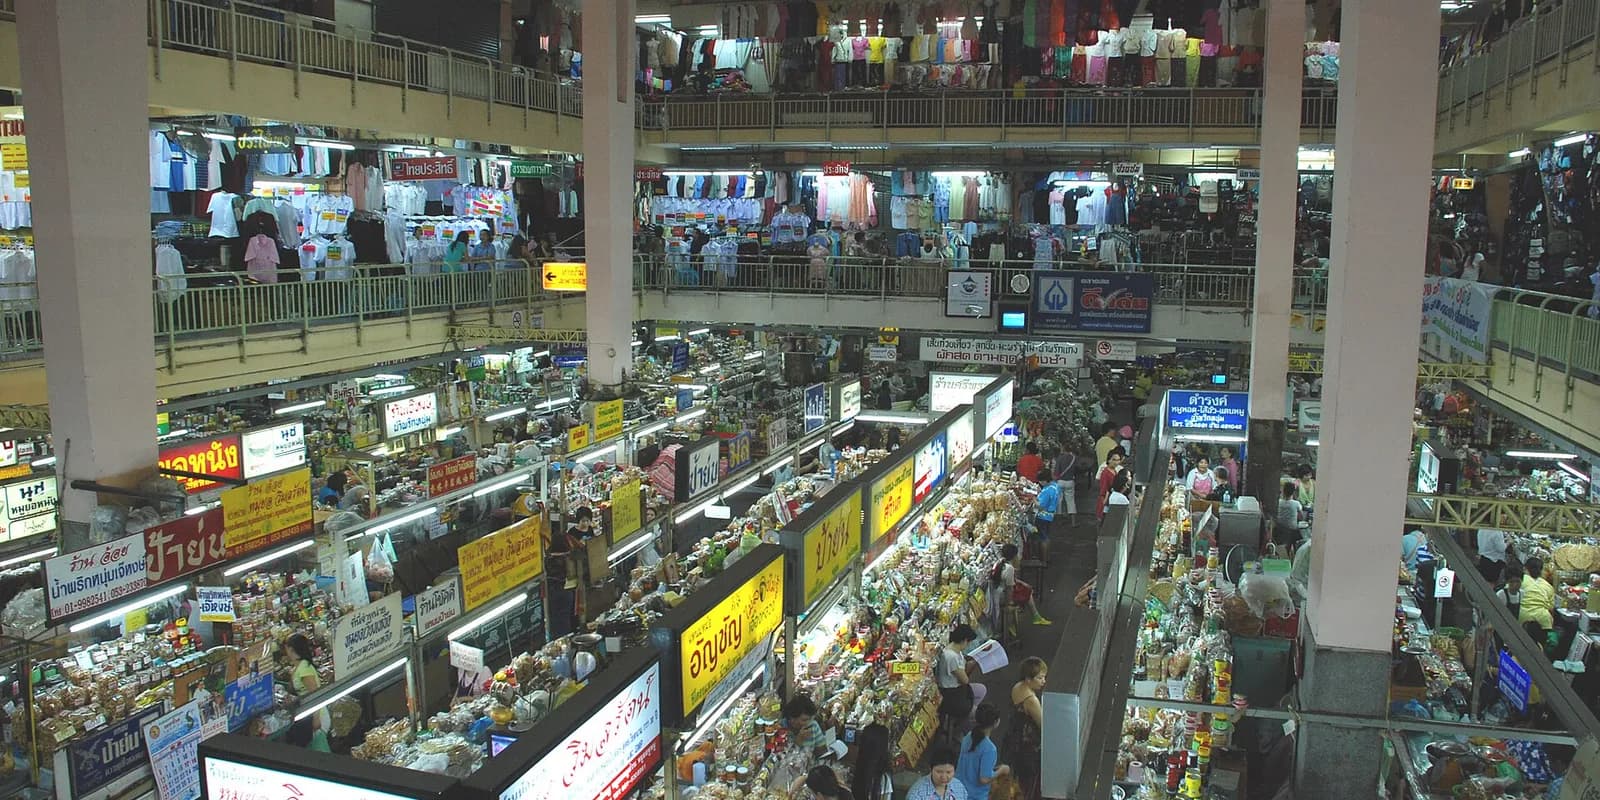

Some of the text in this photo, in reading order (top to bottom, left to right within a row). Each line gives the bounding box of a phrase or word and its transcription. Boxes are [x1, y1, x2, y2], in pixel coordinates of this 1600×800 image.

[1188, 393, 1228, 407] ดำรงค์
[69, 554, 95, 573] ร้าน
